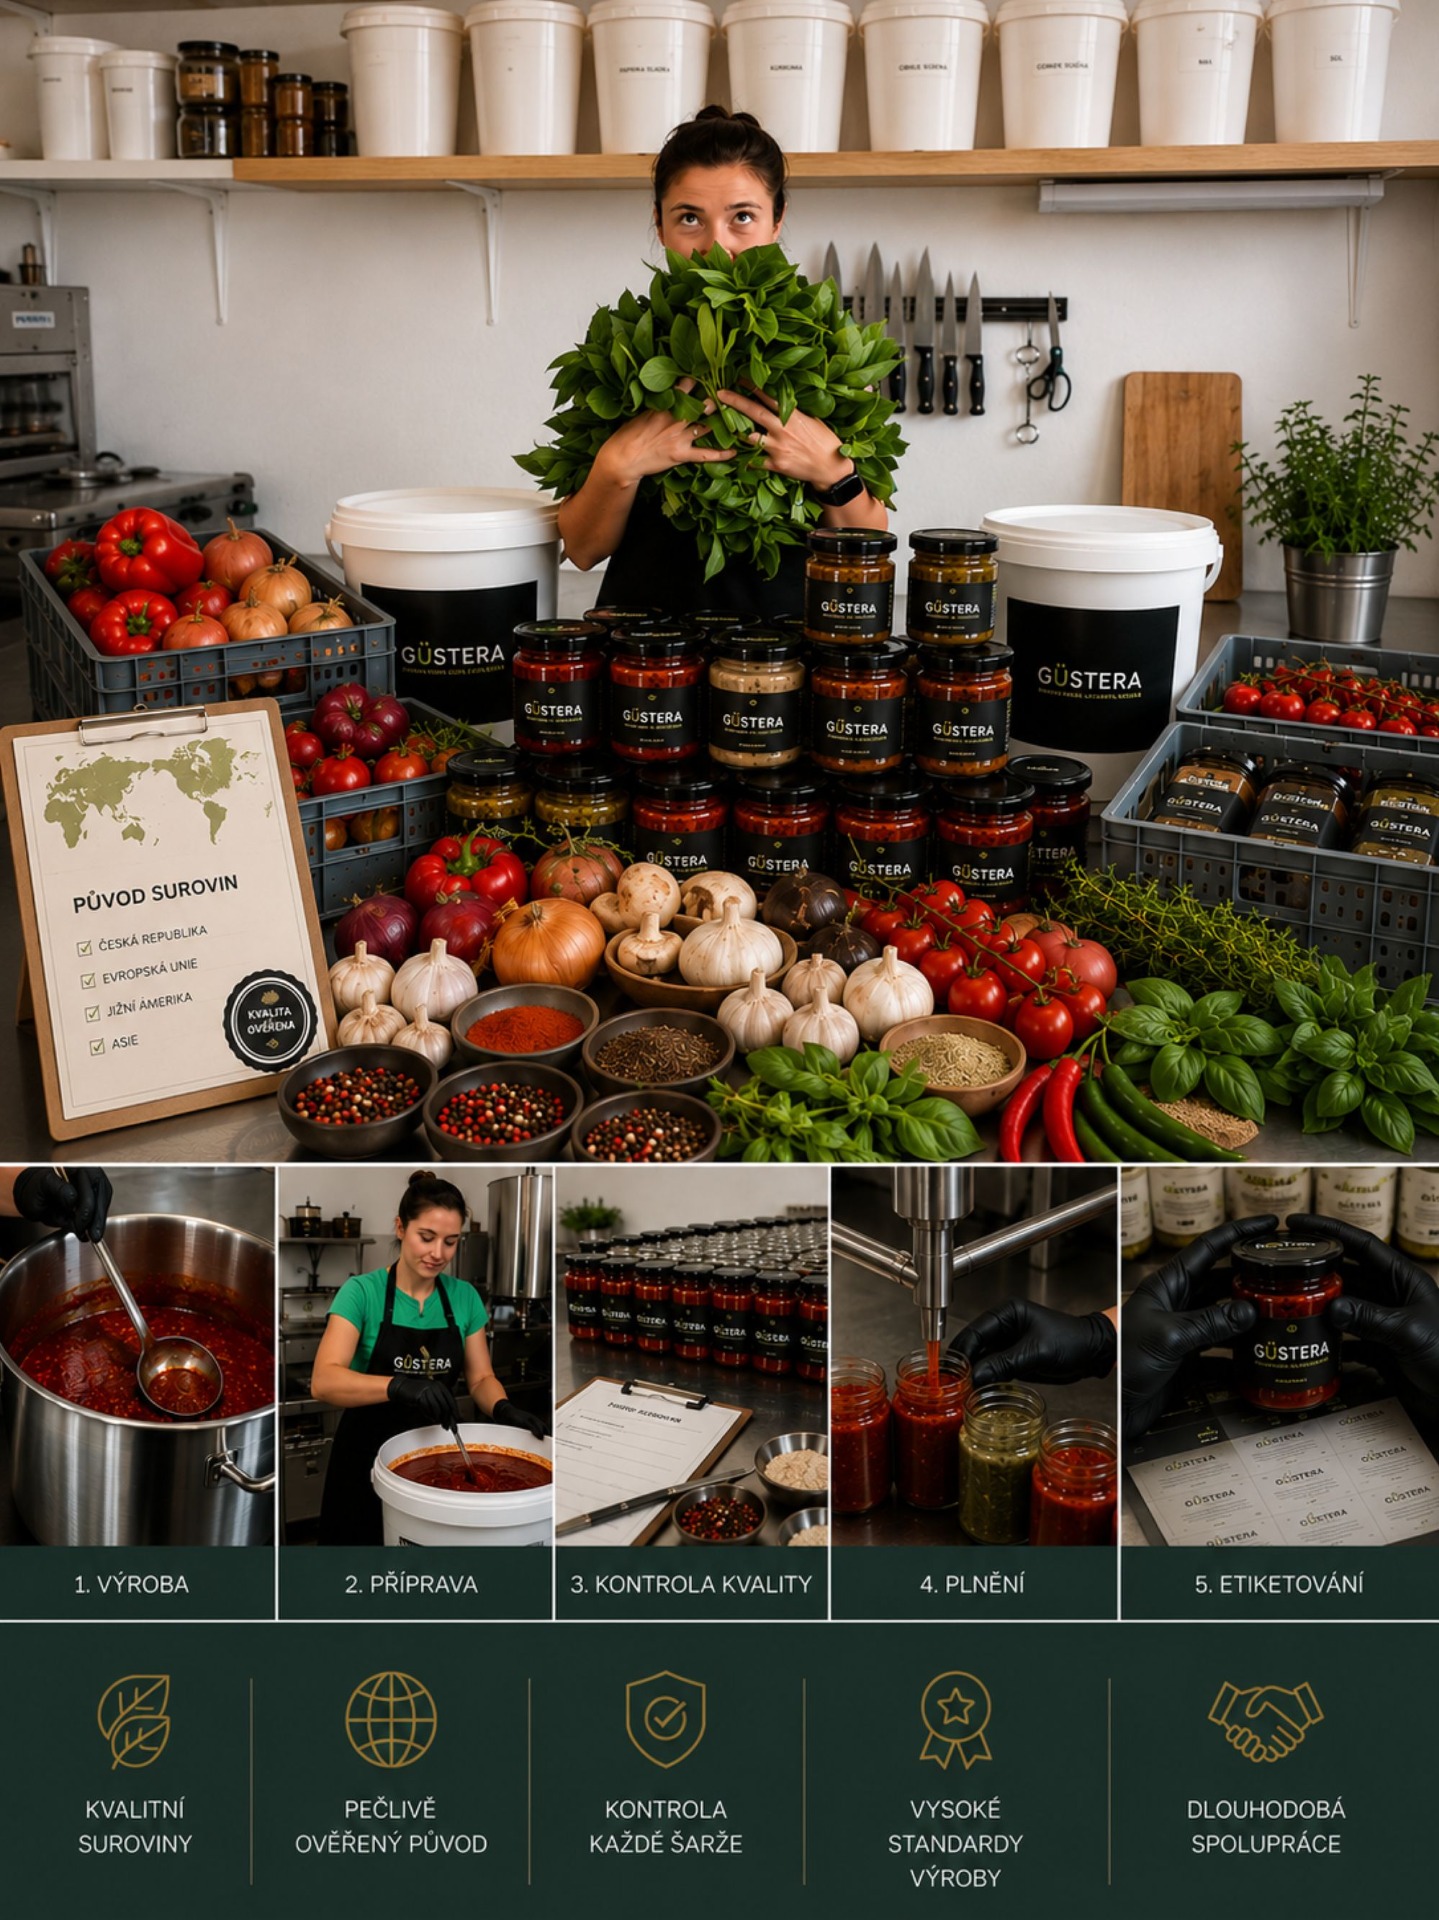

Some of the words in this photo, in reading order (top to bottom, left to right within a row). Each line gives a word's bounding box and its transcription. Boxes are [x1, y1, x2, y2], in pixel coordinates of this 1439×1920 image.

[821, 599, 877, 614] GÜSTERA
[925, 599, 980, 614] GÜSTERA
[401, 641, 505, 666] GÜSTERA
[1038, 663, 1142, 690] GÜSTERA
[524, 701, 583, 717] GÜSTERA
[623, 708, 683, 724] GÜSTERA
[723, 711, 784, 729] GÜSTERA
[826, 720, 888, 735] GÜSTERA
[932, 721, 994, 737] GÜSTERA
[646, 851, 708, 867] GÜSTERA
[748, 854, 809, 871] GÜSTERA
[849, 859, 912, 875] GÜSTERA
[952, 864, 1014, 880] GÜSTERA
[73, 889, 146, 913] PŮVOD
[151, 874, 239, 901] SUROVIN
[98, 933, 140, 951] ČESKÁ
[142, 925, 208, 944] REPUBLIKA
[102, 961, 168, 984] EVROPSKÁ
[170, 958, 198, 972] UNIE
[248, 1006, 292, 1019] KVALITA
[112, 1034, 139, 1050] ASIE
[1254, 1341, 1329, 1360] GÜSTERA
